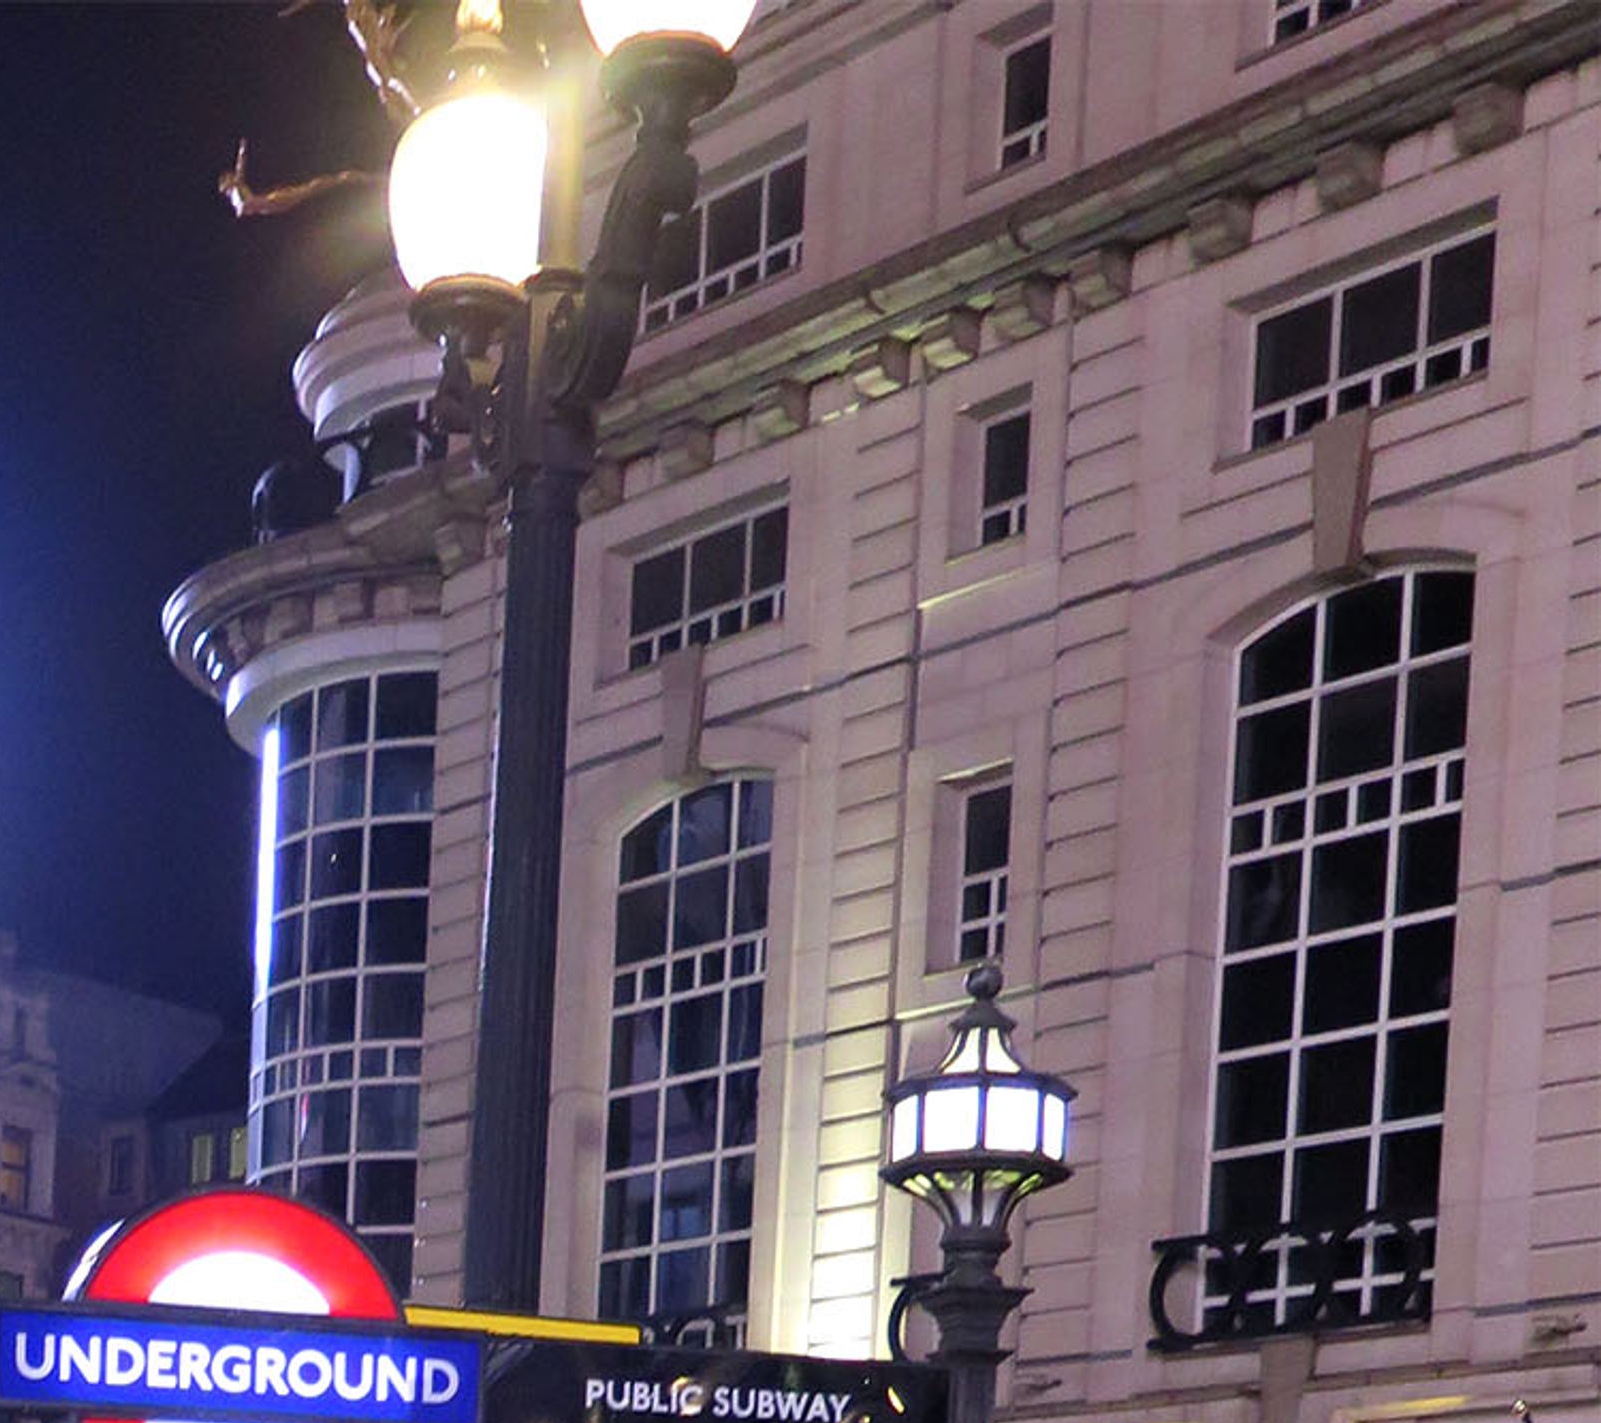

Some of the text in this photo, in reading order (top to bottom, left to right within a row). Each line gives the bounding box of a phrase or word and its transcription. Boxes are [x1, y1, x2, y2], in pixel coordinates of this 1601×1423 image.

[14, 1331, 461, 1405] UNDERGROUND
[585, 1378, 851, 1423] PUBLIC SUBWAY
